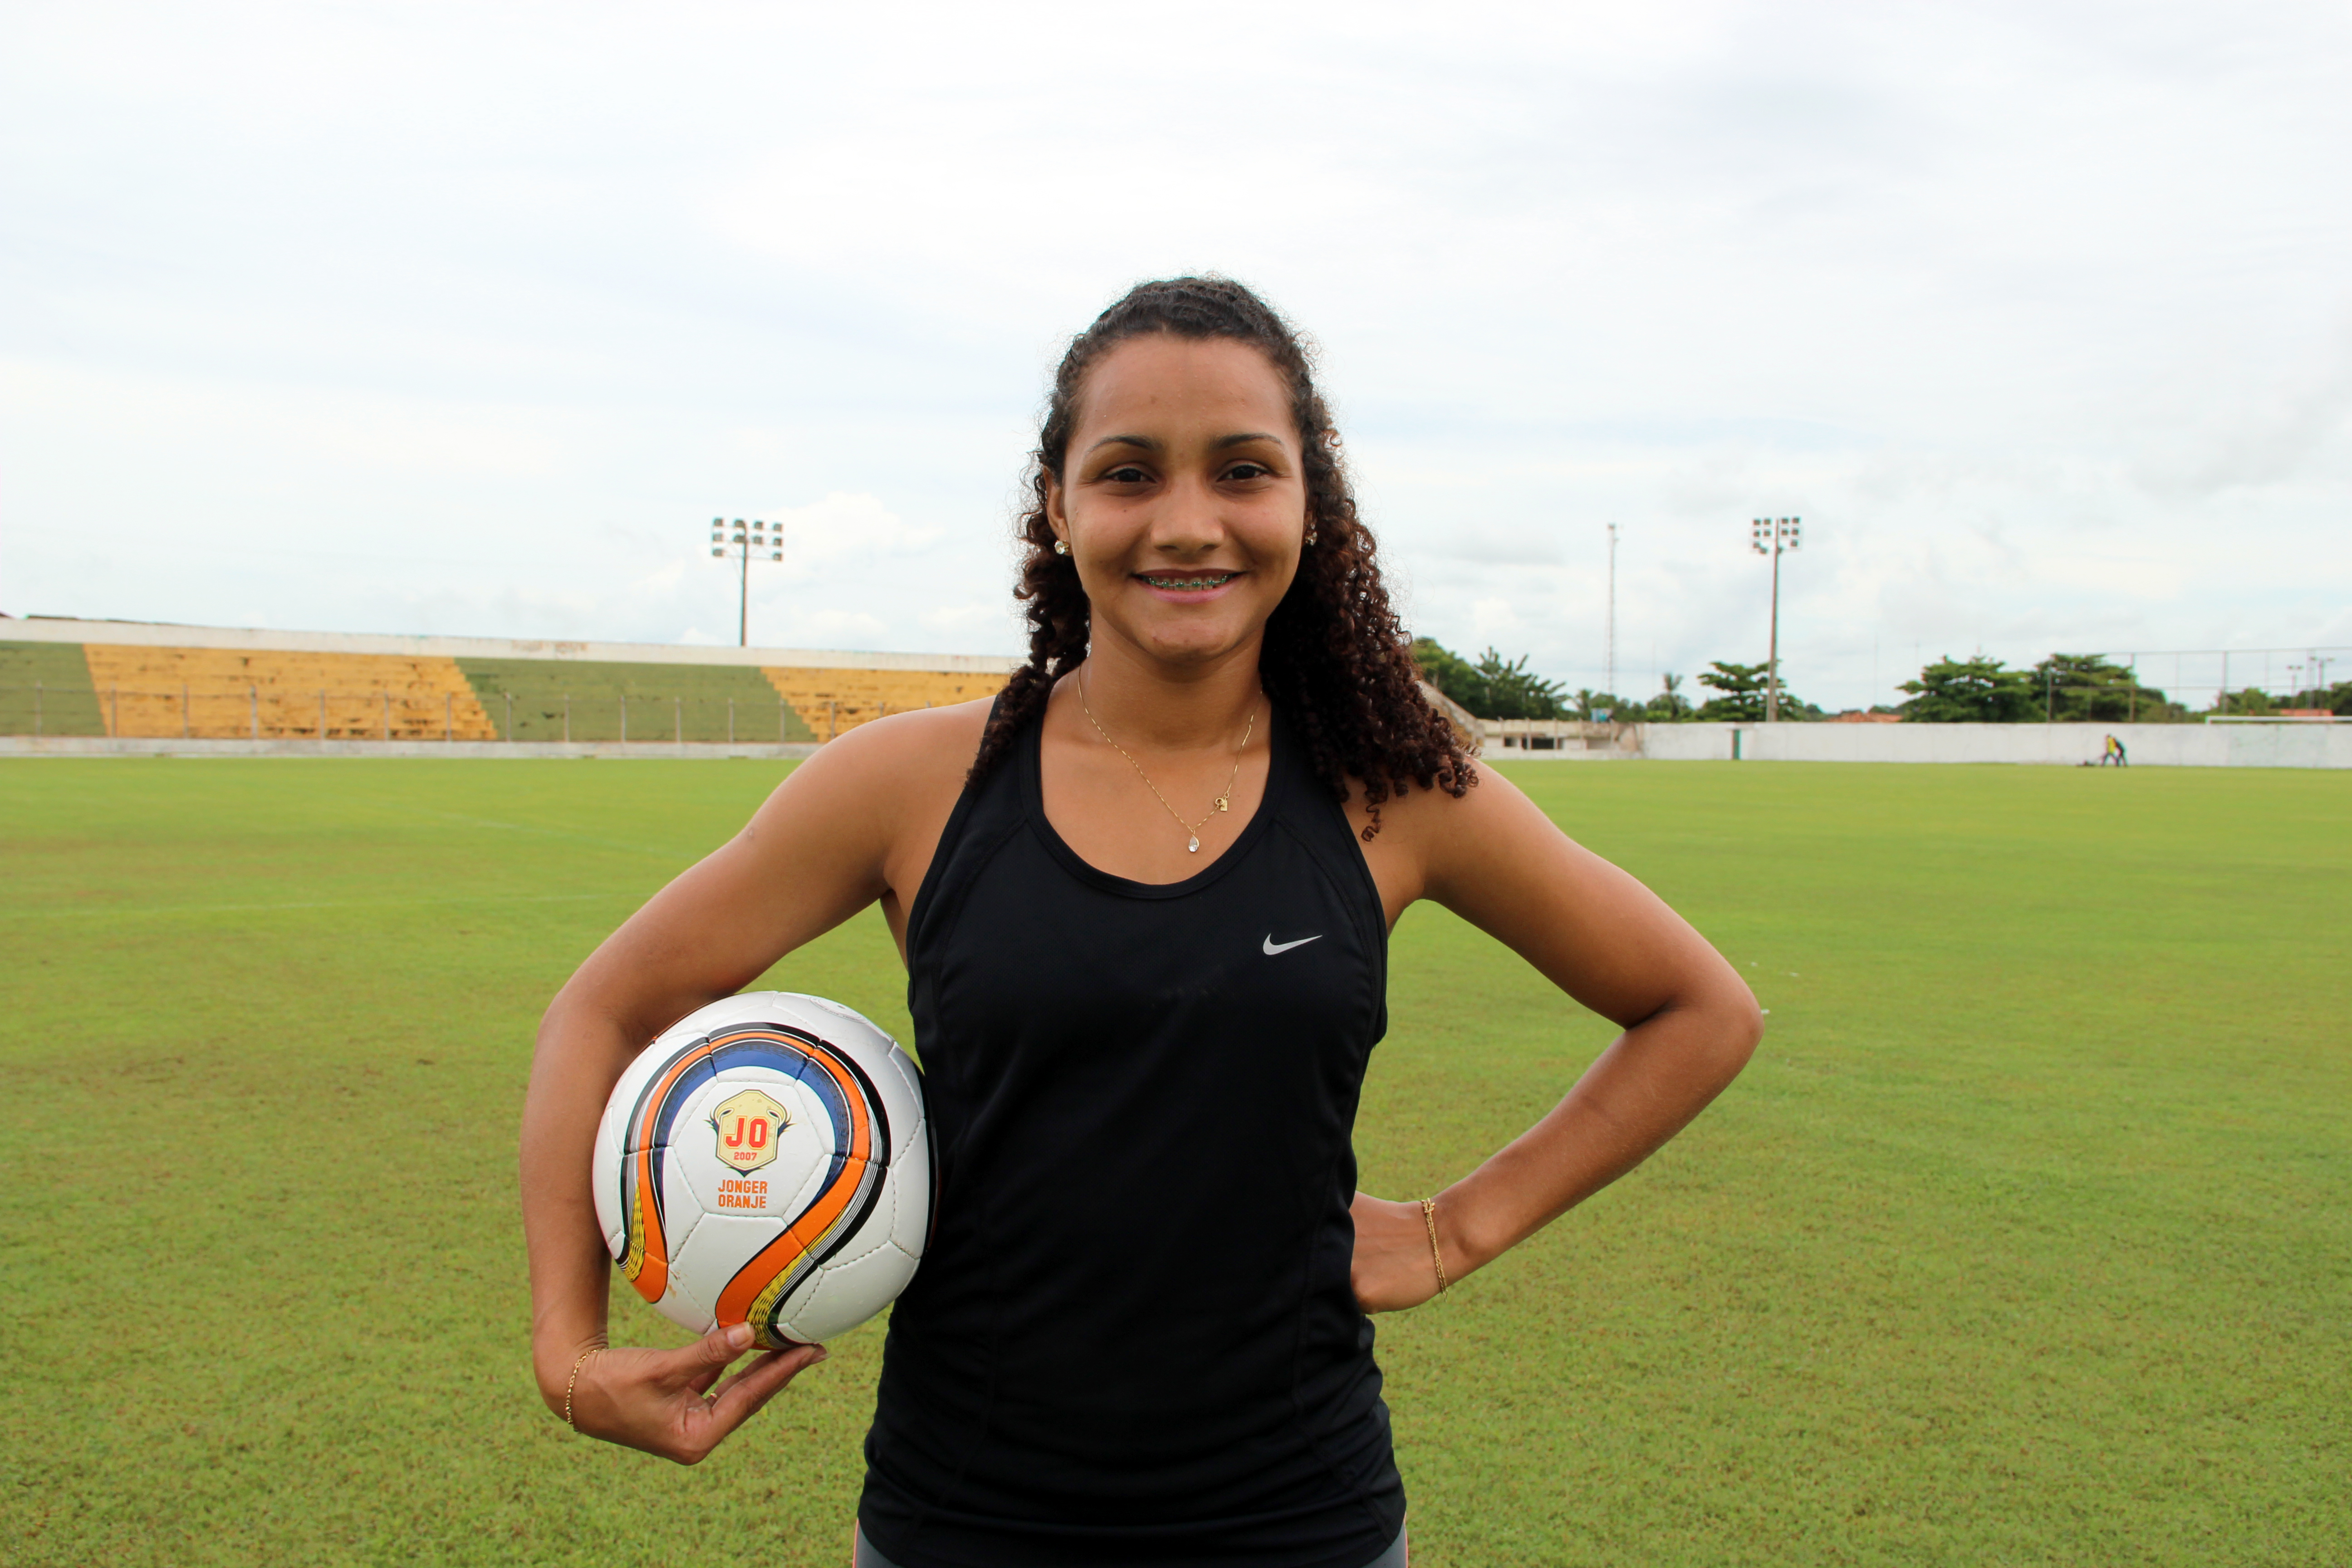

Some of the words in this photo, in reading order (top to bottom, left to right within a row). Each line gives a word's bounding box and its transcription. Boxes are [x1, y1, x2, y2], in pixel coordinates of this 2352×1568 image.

[724, 1116, 769, 1150] JO
[734, 1152, 757, 1161] 2007
[718, 1179, 768, 1194] JONGER
[718, 1194, 766, 1208] ORANJE
